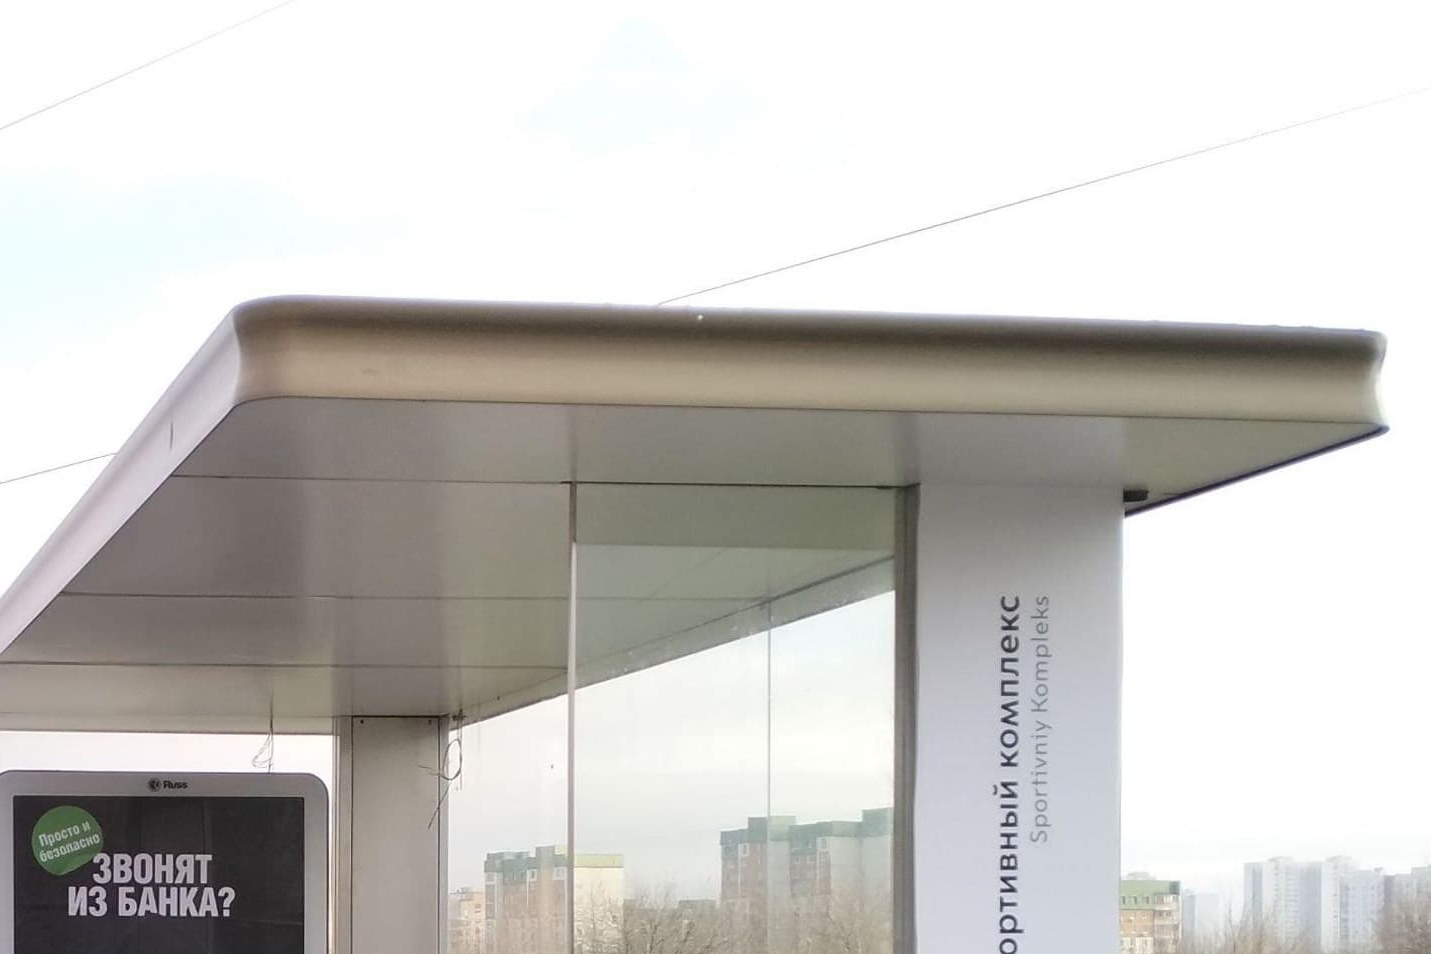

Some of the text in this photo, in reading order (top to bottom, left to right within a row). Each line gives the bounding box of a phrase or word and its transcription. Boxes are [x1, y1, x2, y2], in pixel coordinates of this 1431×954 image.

[999, 595, 1021, 767] комплекс
[1030, 595, 1052, 843] Sportivniy Kompleks
[162, 779, 188, 789] Russ
[38, 820, 91, 848] Просто и
[39, 832, 101, 863] безопасно
[92, 853, 213, 885] ЗВОНЯТ
[67, 886, 236, 918] ИЗ БАНКА?
